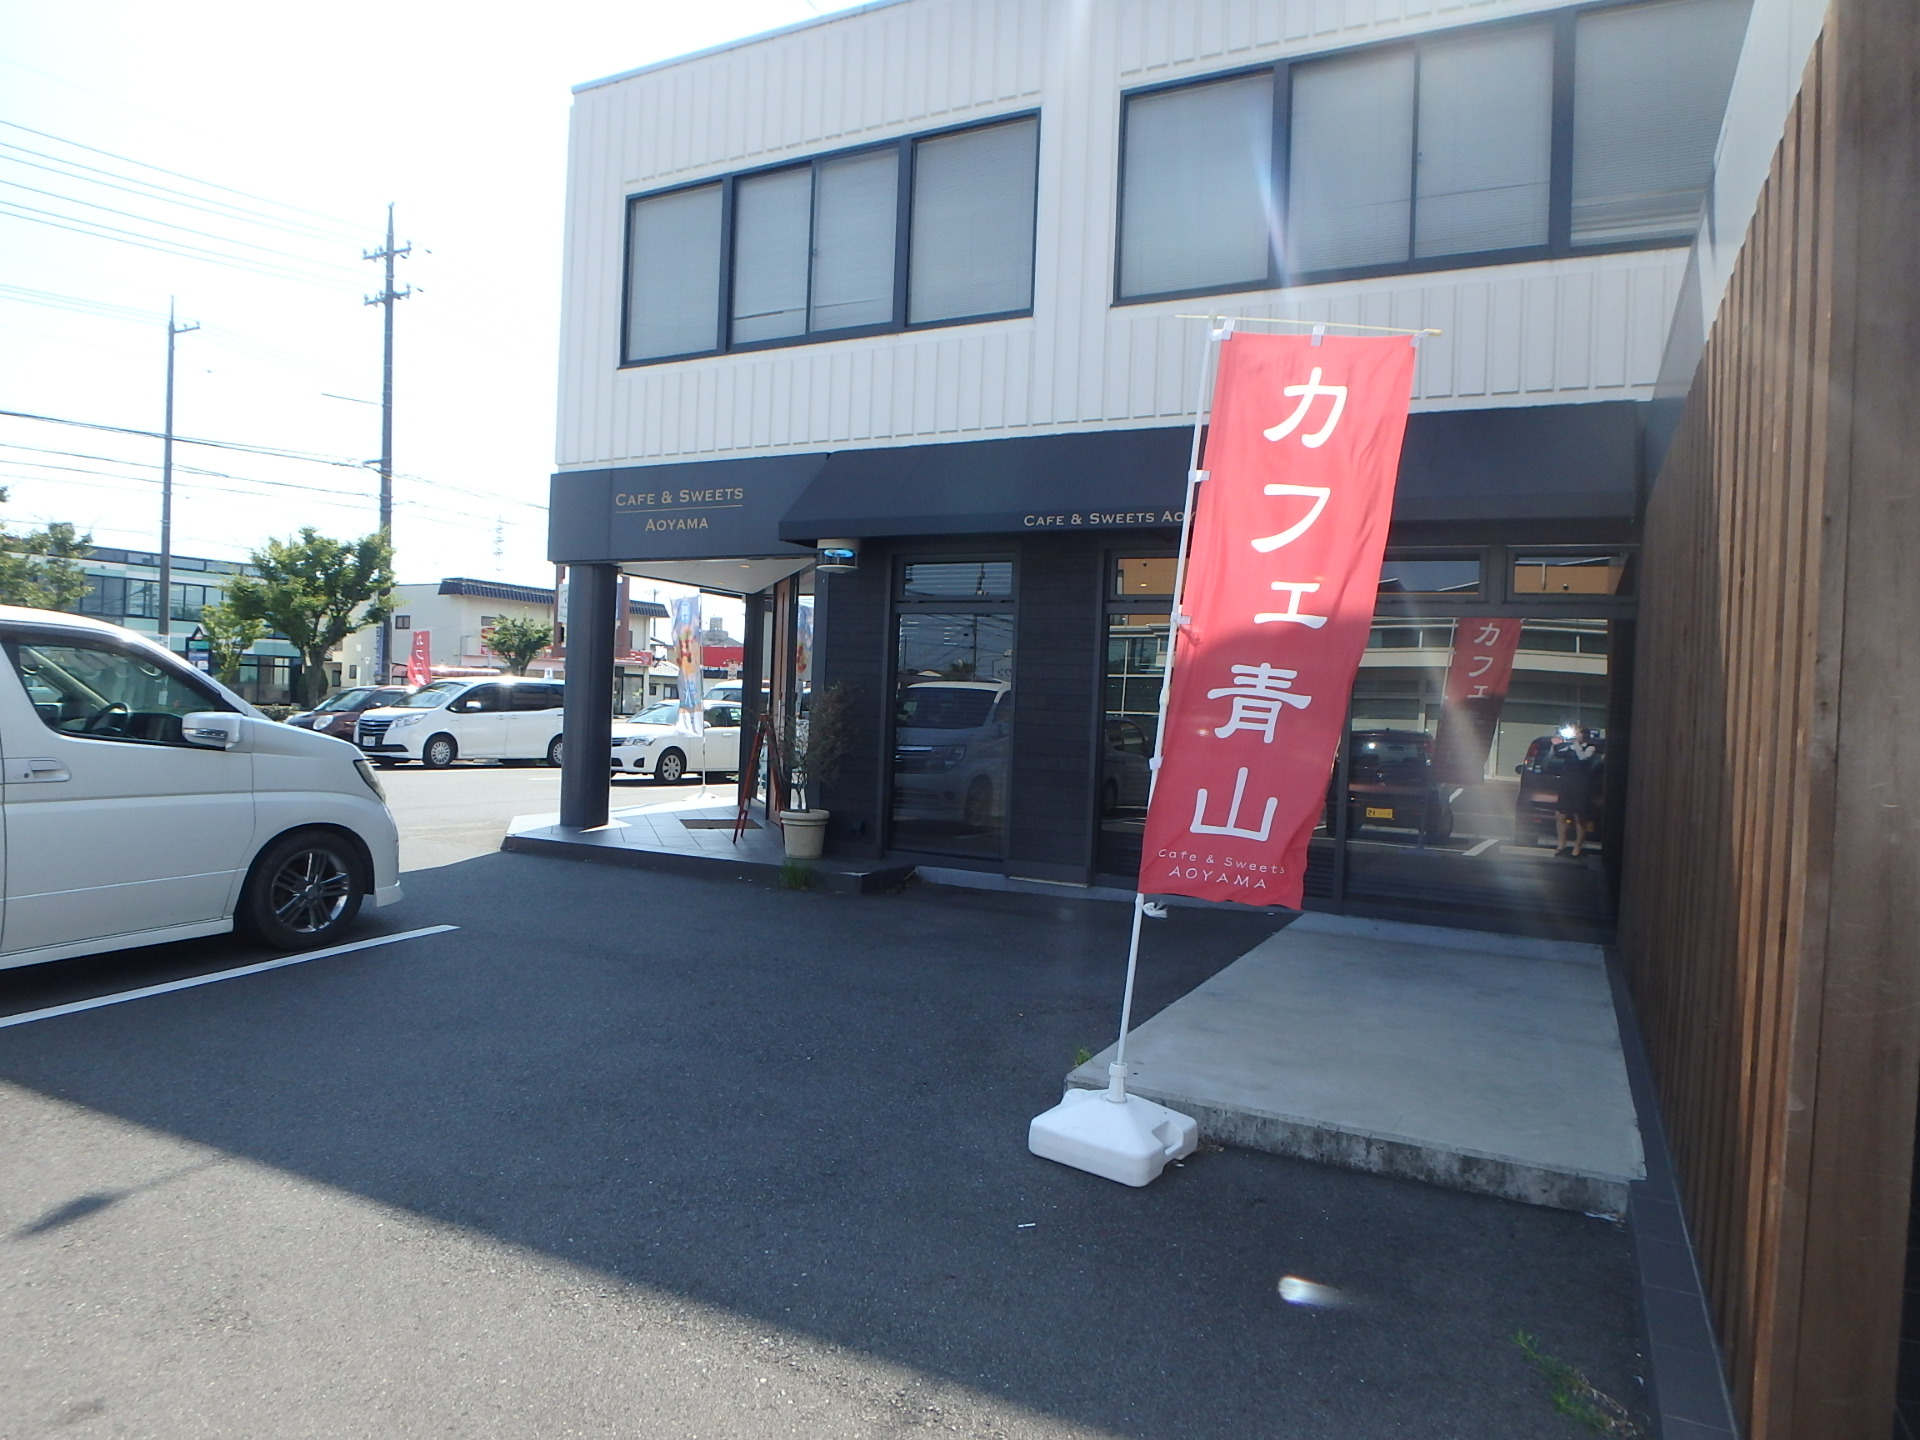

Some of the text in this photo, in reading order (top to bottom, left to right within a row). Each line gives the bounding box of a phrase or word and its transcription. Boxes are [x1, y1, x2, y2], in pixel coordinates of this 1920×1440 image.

[615, 487, 744, 506] CAFE & SWEETS
[644, 517, 709, 532] AOYAMA
[1023, 515, 1064, 527] CAFE
[1070, 513, 1082, 525] &
[1089, 512, 1155, 525] SWEETS
[1188, 364, 1349, 843] カフェ青山
[1158, 849, 1286, 874] Cafe & Sweets
[1168, 865, 1267, 889] AOYAMA
